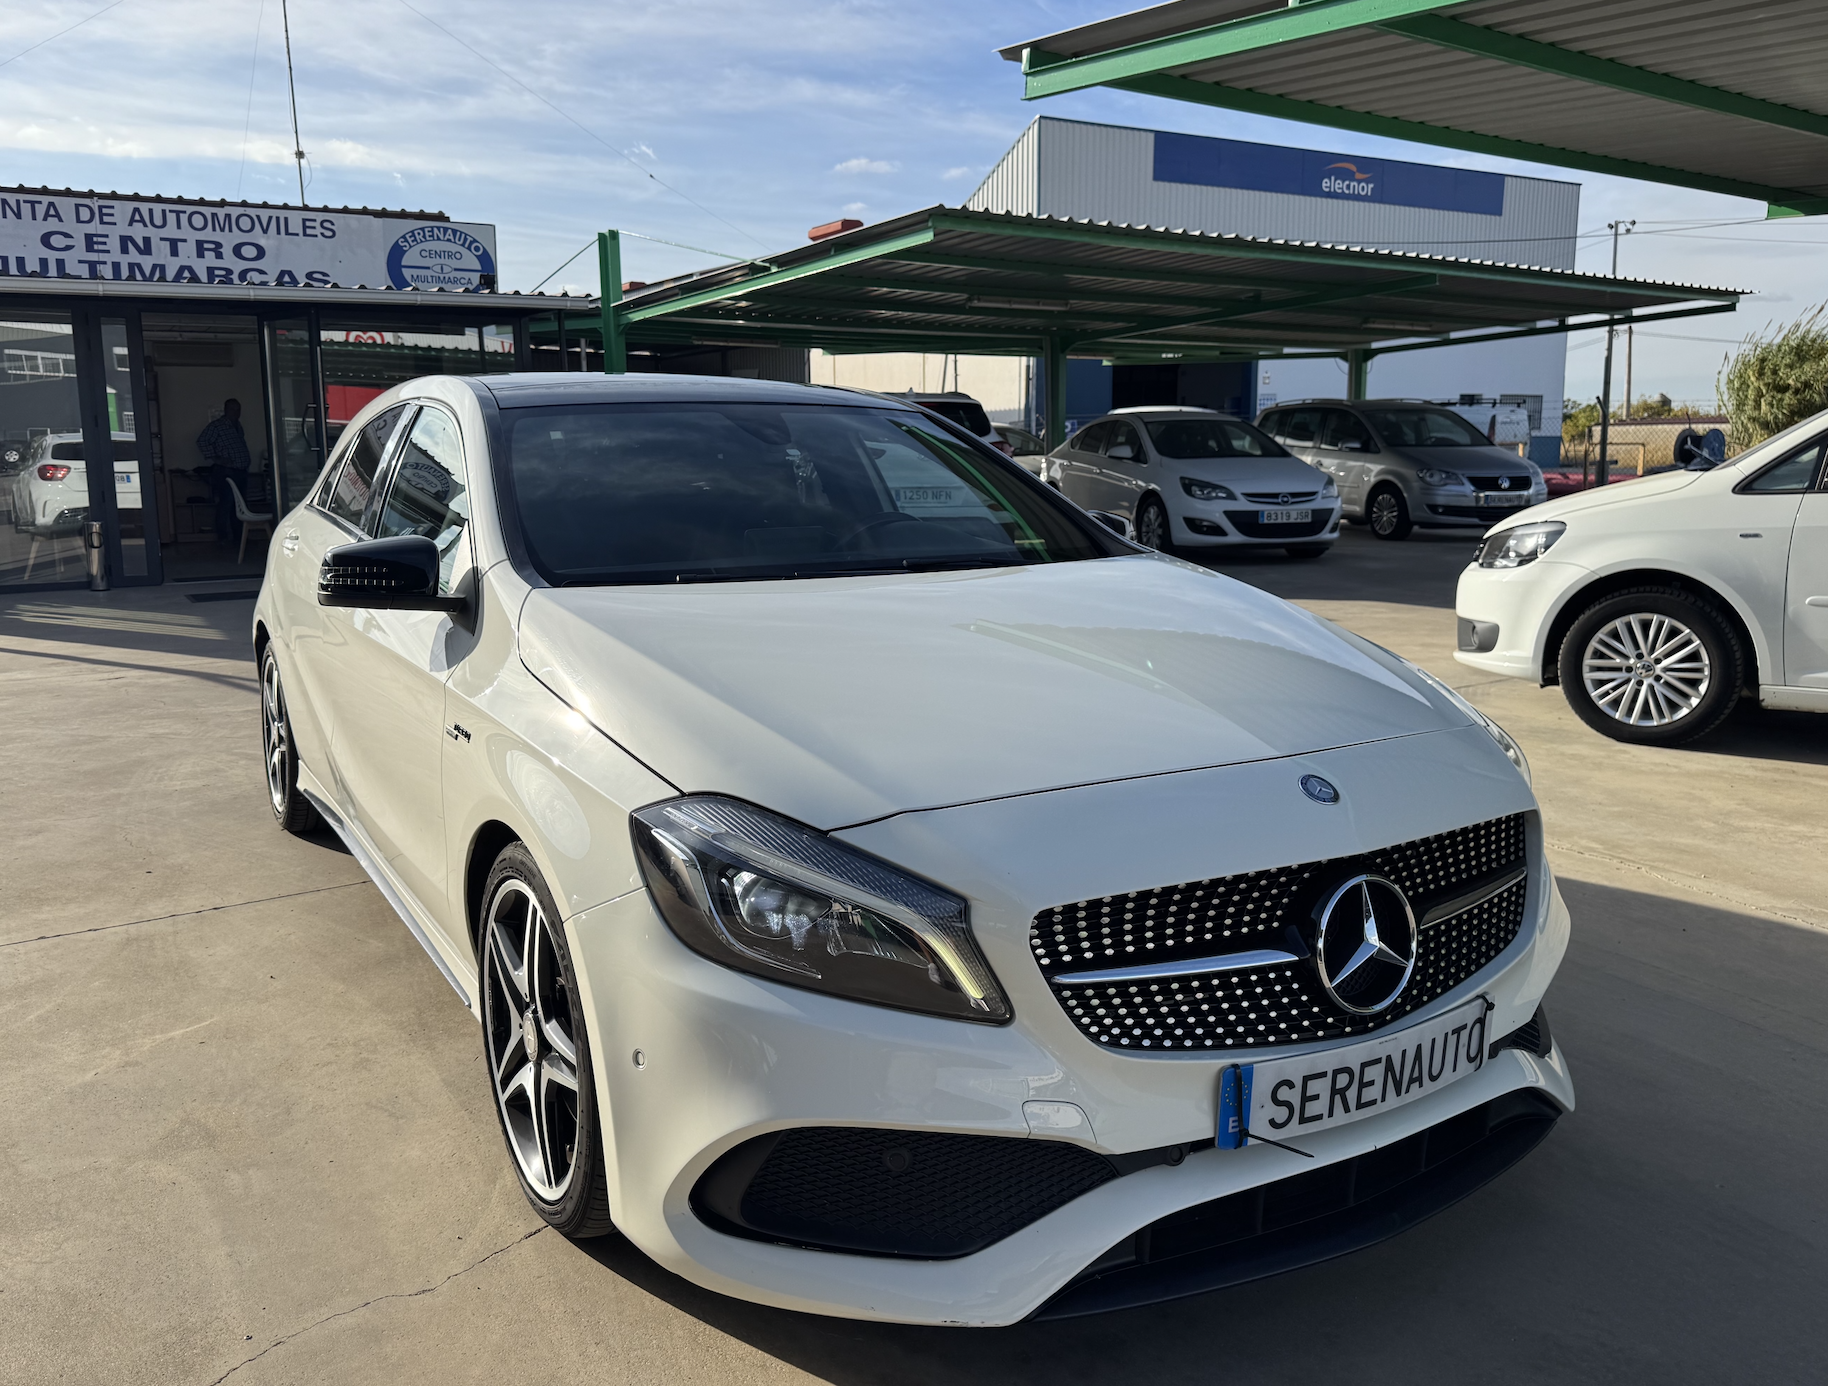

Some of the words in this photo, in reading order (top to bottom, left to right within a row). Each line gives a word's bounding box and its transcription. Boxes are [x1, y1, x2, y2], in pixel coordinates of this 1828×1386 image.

[1321, 175, 1374, 196] elecnor
[74, 203, 117, 226] DE
[40, 230, 266, 262] CENTRO
[398, 227, 484, 256] SERENAUTO
[419, 248, 463, 261] CENTRO
[0, 255, 333, 288] ULTIMARCAS
[410, 274, 474, 286] MULTIMARCA
[902, 490, 928, 500] 1250
[931, 490, 952, 500] NFN
[1266, 511, 1290, 521] 8319
[1294, 511, 1310, 521] JSR
[1268, 1016, 1486, 1130] SERENAUTO
